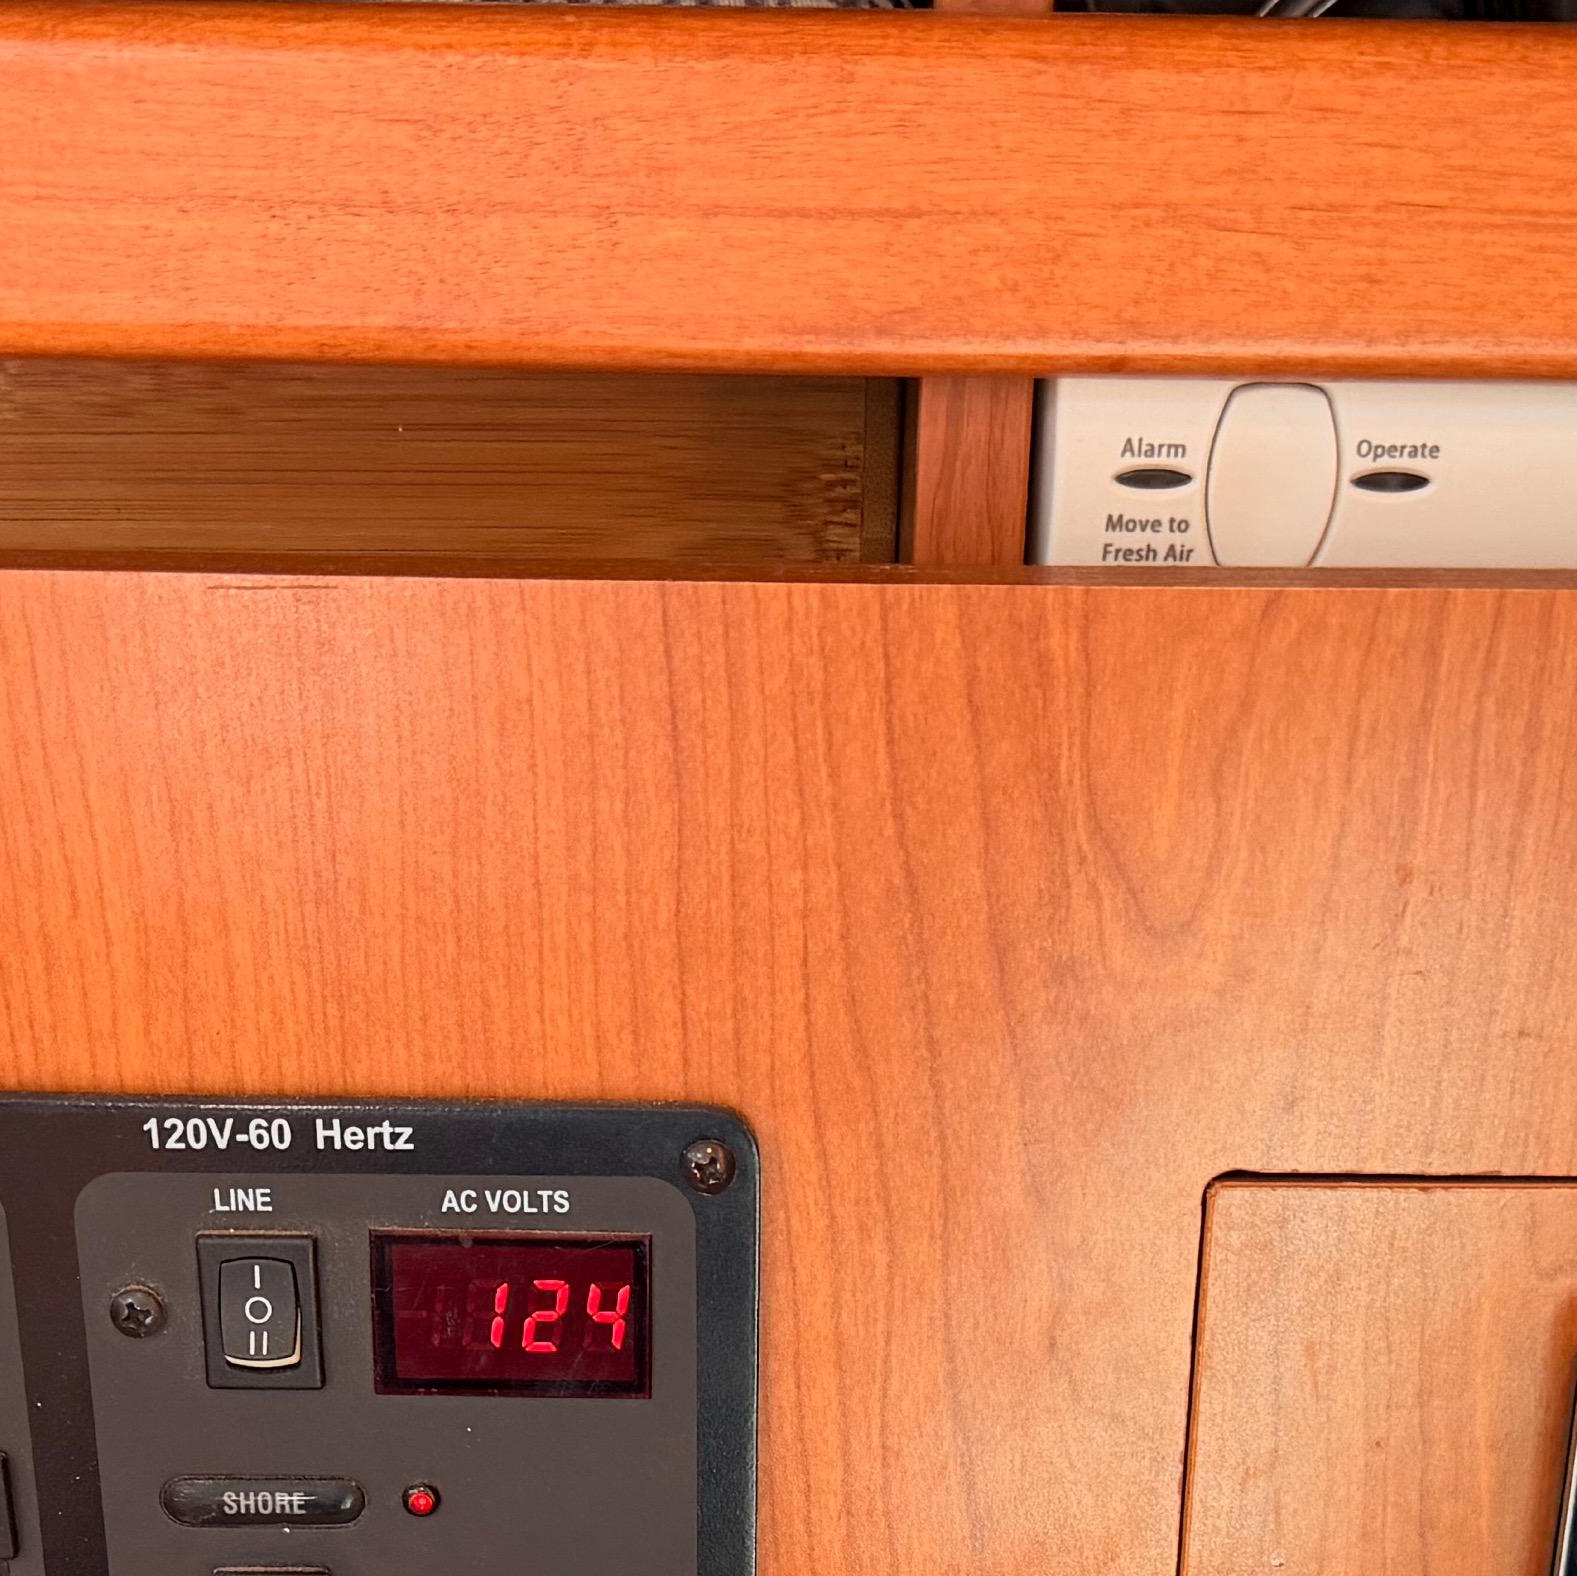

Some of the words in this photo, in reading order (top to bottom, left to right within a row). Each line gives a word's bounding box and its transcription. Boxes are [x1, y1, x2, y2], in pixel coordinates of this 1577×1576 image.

[1121, 438, 1187, 458] Alarm
[1356, 439, 1440, 463] Operate
[1105, 514, 1163, 533] Move
[1168, 517, 1190, 533] to
[1102, 543, 1158, 562] Fresh
[1163, 544, 1194, 562] Air
[142, 1118, 292, 1151] 120V-60
[315, 1119, 415, 1151] Hertz
[214, 1189, 273, 1211] LINE
[441, 1190, 478, 1213] AC
[483, 1190, 570, 1213] VOLTS
[490, 1279, 630, 1353] 124
[222, 1491, 307, 1515] SHORE
